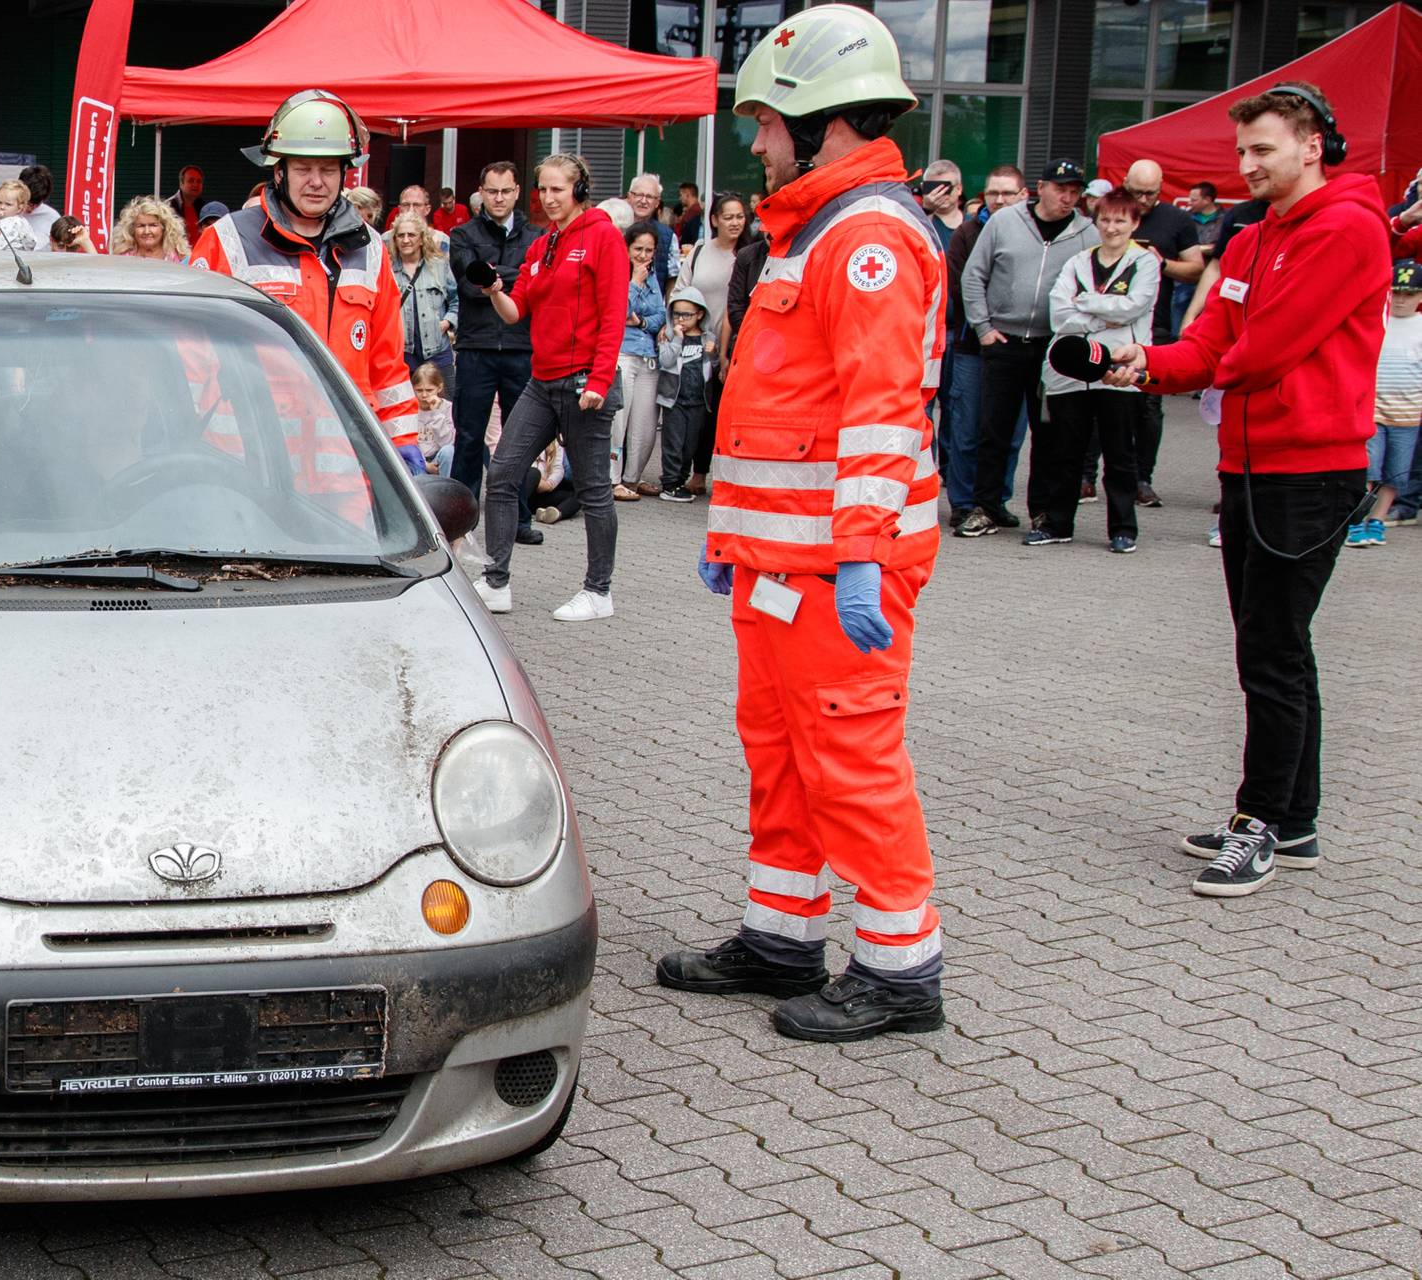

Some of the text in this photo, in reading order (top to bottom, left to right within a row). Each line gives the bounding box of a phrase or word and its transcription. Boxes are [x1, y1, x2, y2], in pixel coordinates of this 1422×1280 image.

[85, 112, 98, 182] essen
[853, 248, 890, 266] DEUTSCHES
[852, 267, 892, 288] ROTES KREUZ
[682, 345, 702, 357] NIKE
[136, 1076, 170, 1087] Center
[172, 1075, 203, 1086] Essen
[213, 1074, 248, 1084] E-Mitte
[269, 1071, 299, 1082] (0201)
[301, 1070, 313, 1079] 82
[315, 1069, 327, 1078] 75
[329, 1068, 344, 1077] 1-0
